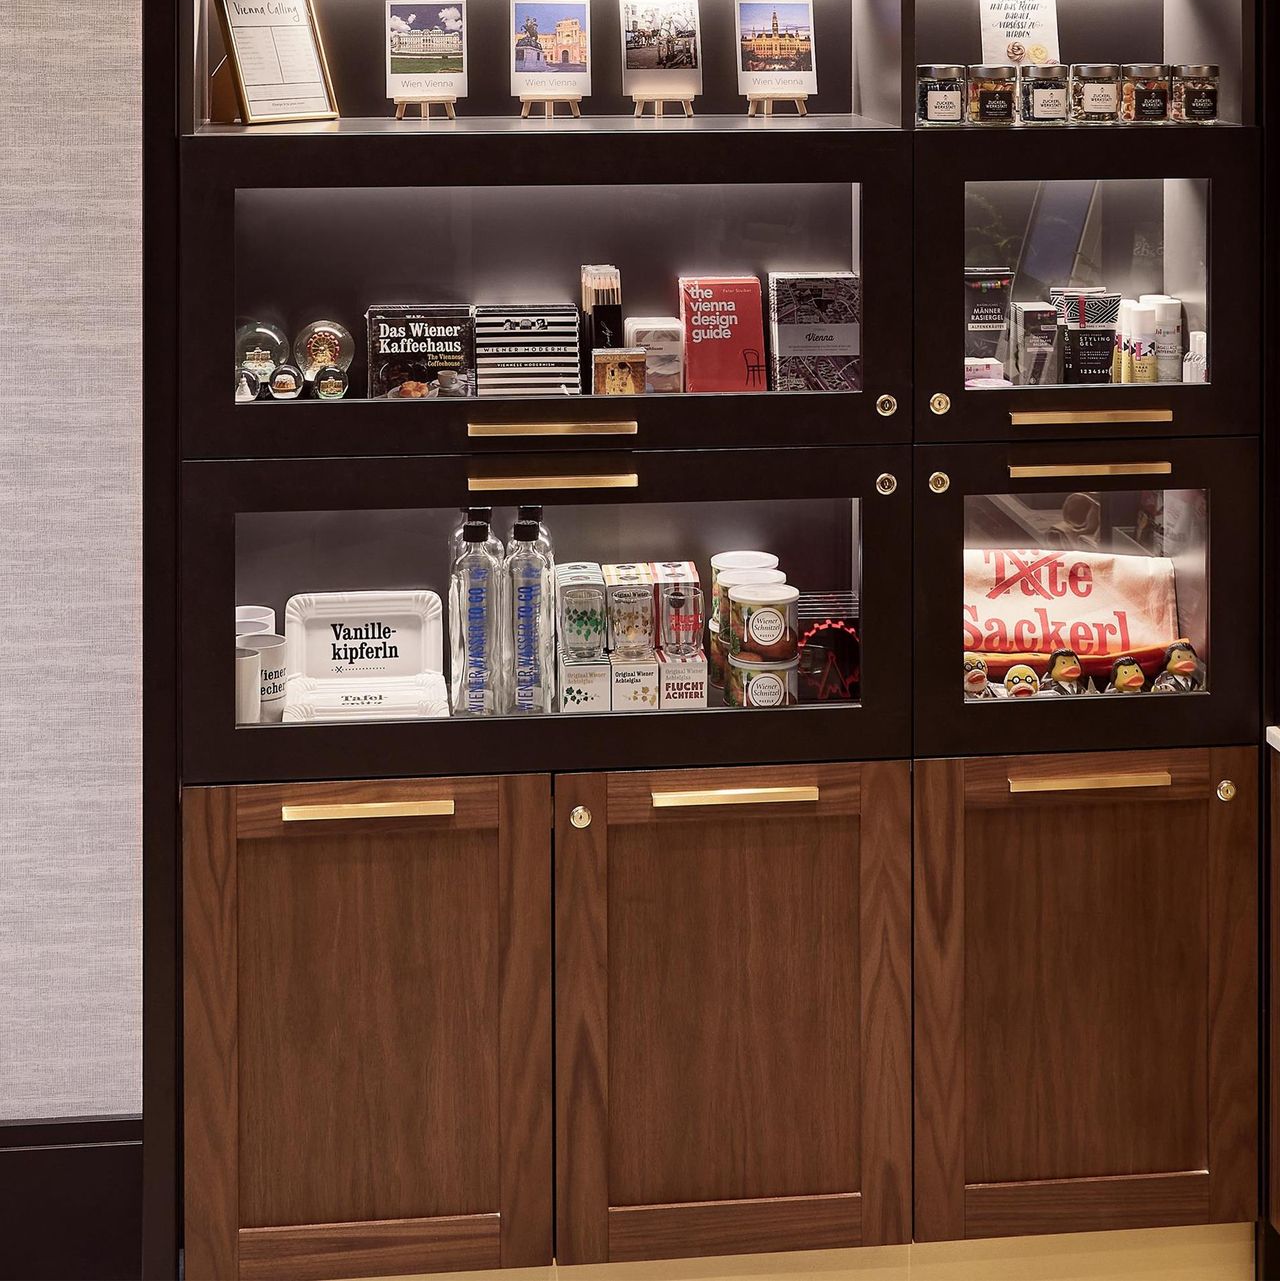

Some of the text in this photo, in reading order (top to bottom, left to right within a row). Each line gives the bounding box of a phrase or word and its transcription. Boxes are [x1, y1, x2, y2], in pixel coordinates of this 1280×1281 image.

[233, 2, 300, 22] Vienna Calling
[401, 80, 454, 88] Wien Vienna
[525, 79, 577, 87] Wien Vienna
[690, 283, 713, 298] the
[690, 299, 736, 312] vienna
[691, 312, 738, 328] design
[379, 322, 461, 338] Das Wiener
[691, 326, 732, 343] guide
[805, 332, 835, 342] Vienna
[379, 339, 462, 354] Kaffeehaus
[330, 622, 397, 640] Vanille-
[331, 642, 399, 665] kipferln
[468, 587, 484, 712] WIENER WASSER TO GO
[517, 586, 533, 711] WIENER WASSER TO GO
[260, 682, 285, 696] echer
[665, 682, 704, 691] FLUCHT
[665, 691, 704, 699] ACHTERL
